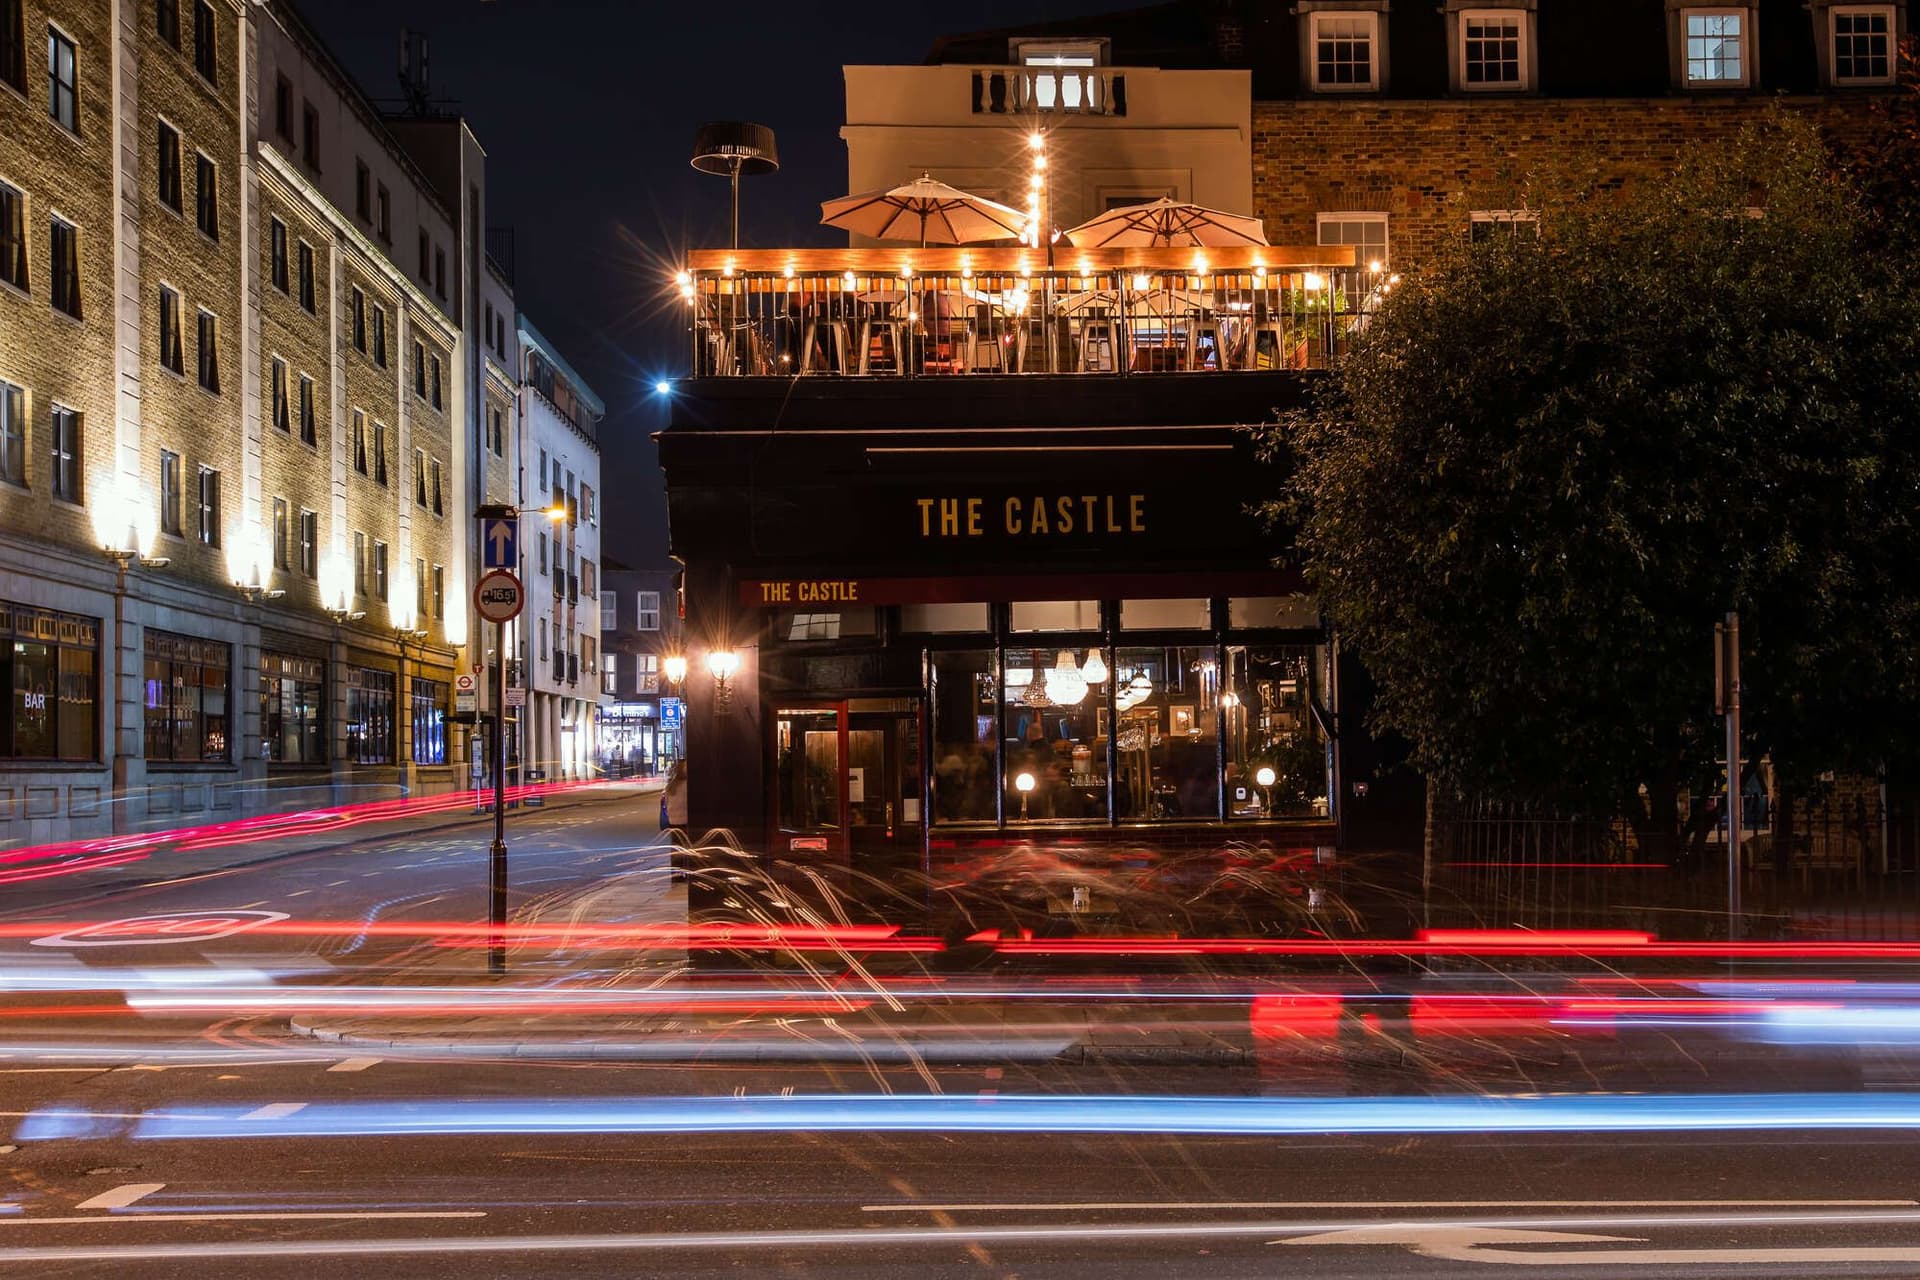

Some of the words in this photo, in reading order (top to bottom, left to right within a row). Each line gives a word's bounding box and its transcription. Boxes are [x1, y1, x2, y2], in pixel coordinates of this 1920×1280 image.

[917, 498, 984, 536] THE
[1005, 495, 1146, 534] CASTLE
[761, 583, 791, 601] THE
[799, 582, 858, 601] CASTLE
[24, 692, 45, 710] BAR
[79, 918, 241, 938] 20
